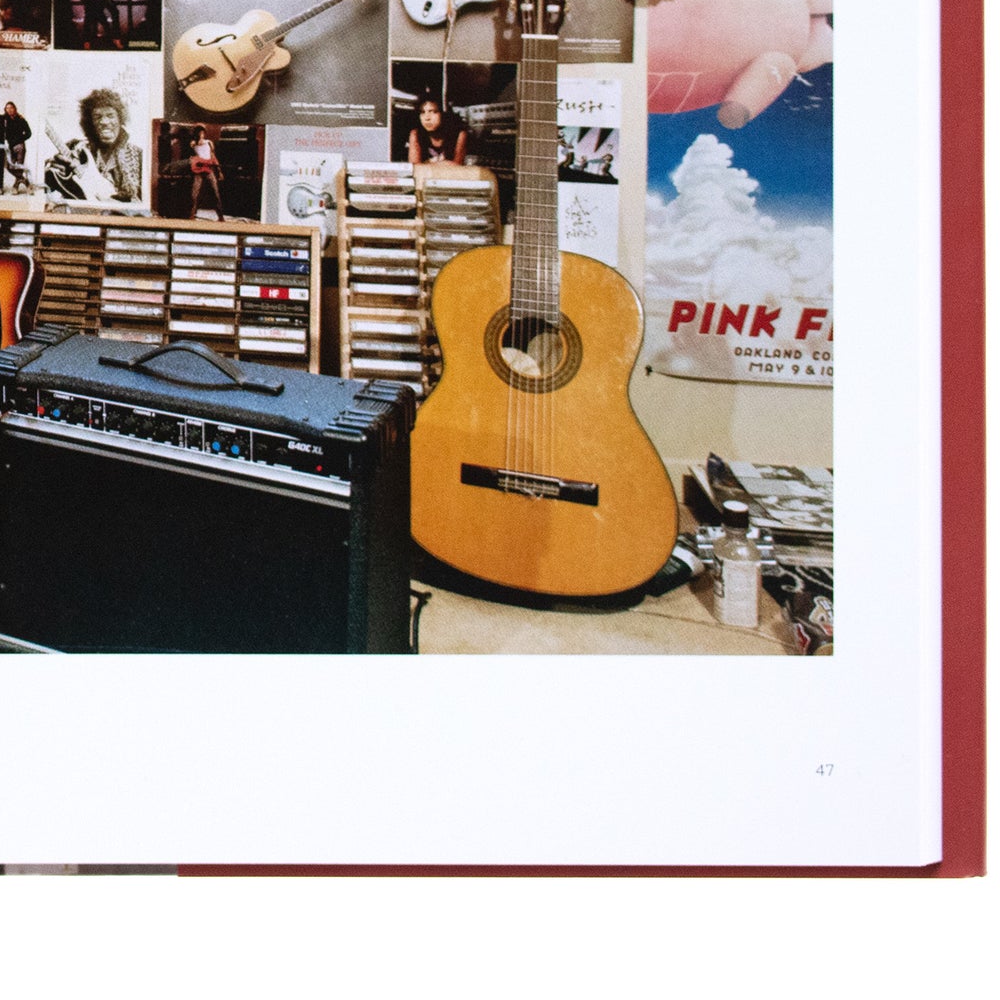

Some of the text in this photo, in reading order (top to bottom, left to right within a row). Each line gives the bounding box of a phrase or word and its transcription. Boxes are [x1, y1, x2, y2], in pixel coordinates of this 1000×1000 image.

[3, 32, 41, 43] HAMER
[264, 249, 289, 258] Scotch
[667, 300, 834, 342] PINK F
[734, 346, 834, 361] OAKLAND CO
[749, 362, 784, 373] MAY
[791, 364, 800, 375] 9
[805, 363, 815, 375] &
[312, 445, 324, 455] XL
[815, 764, 834, 777] 47
